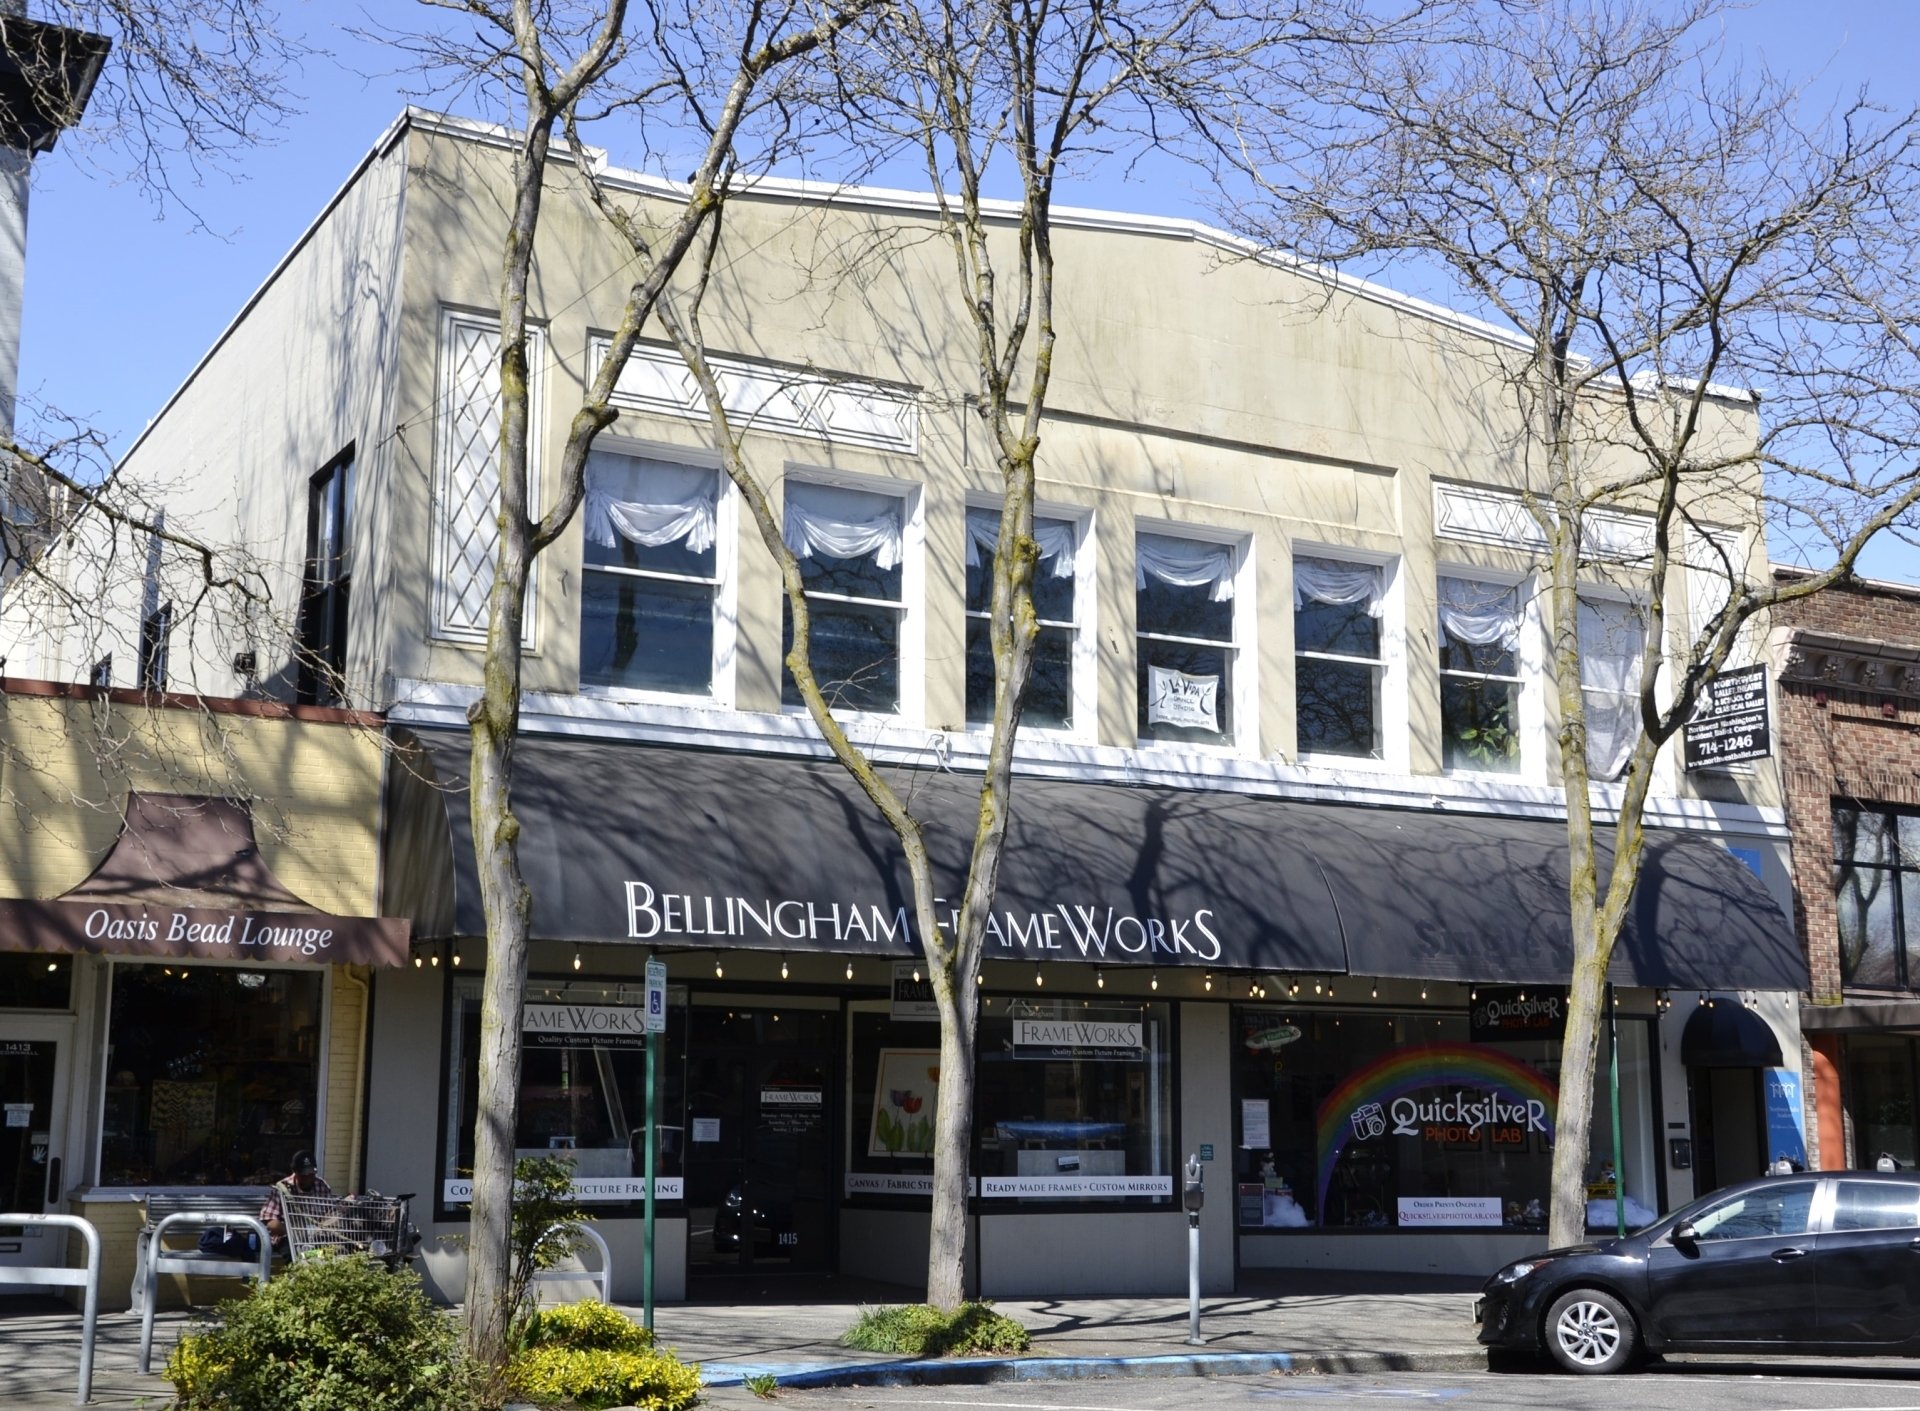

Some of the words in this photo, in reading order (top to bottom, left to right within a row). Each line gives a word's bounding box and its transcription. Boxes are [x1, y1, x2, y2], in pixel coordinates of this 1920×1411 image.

[1714, 672, 1763, 689] NORTHWEST
[1714, 686, 1735, 698] BALLET
[1744, 692, 1754, 700] OF
[1745, 698, 1765, 709] BALLET
[1733, 722, 1764, 732] Company
[1699, 734, 1753, 756] 714-1246
[625, 881, 911, 943] BELLINGHAM
[84, 909, 159, 940] Oasis
[165, 913, 235, 944] Bead
[238, 916, 333, 955] Lounge
[898, 979, 935, 1001] FRAME
[526, 1007, 645, 1034] AMEWORKS
[6, 1043, 31, 1051] 1413
[537, 1036, 563, 1045] Quality
[564, 1036, 590, 1044] Custom
[591, 1037, 614, 1045] Picture
[615, 1038, 642, 1047] Framing
[1051, 1048, 1072, 1056] Quality
[1072, 1048, 1093, 1056] Custom
[1113, 1049, 1135, 1058] Framing
[1425, 1127, 1481, 1143] PHOTO
[1491, 1127, 1522, 1143] LAB
[625, 1183, 678, 1193] FRAING
[848, 1178, 880, 1188] CANVAS
[887, 1179, 916, 1190] FABRIC
[986, 1183, 1017, 1192] READY
[1018, 1183, 1046, 1192] MADE
[1048, 1183, 1082, 1192] FRAMES
[1089, 1182, 1125, 1192] CUSTOM
[1127, 1182, 1168, 1191] MIRRORS
[1413, 1200, 1434, 1208] ORDER
[1434, 1200, 1455, 1208] PRINTS
[1455, 1200, 1477, 1208] ONLINE
[778, 1232, 798, 1245] 1415
